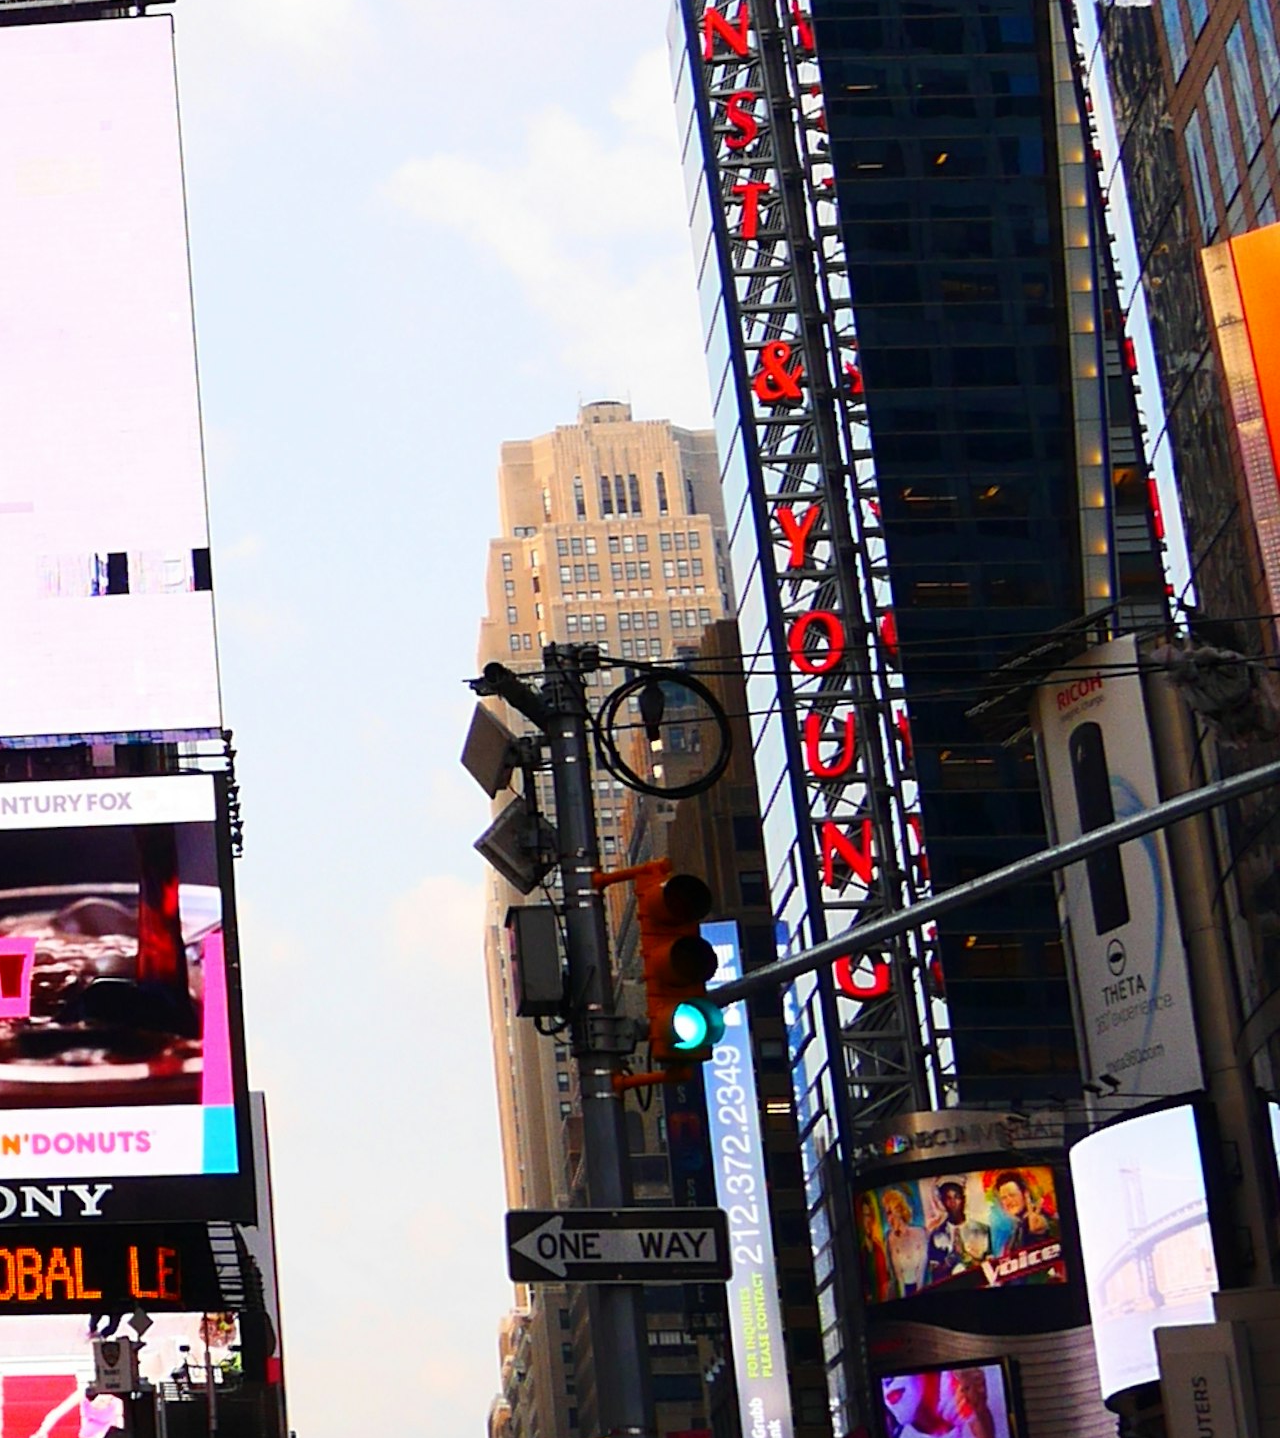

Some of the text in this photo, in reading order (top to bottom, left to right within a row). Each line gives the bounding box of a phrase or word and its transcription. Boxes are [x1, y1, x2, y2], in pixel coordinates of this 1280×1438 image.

[755, 342, 804, 405] &
[1057, 671, 1102, 710] RICOH
[86, 791, 133, 812] FOX
[1101, 973, 1146, 1006] THETA
[30, 1130, 153, 1155] DONUTS
[713, 1044, 763, 1265] 212.372.2349
[538, 1232, 708, 1260] ONE WAY
[981, 1242, 1062, 1288] Voice
[740, 1288, 758, 1378] FOR INQUIRIES
[752, 1273, 773, 1378] PLEASE CONTACT
[749, 1397, 765, 1436] Grubb
